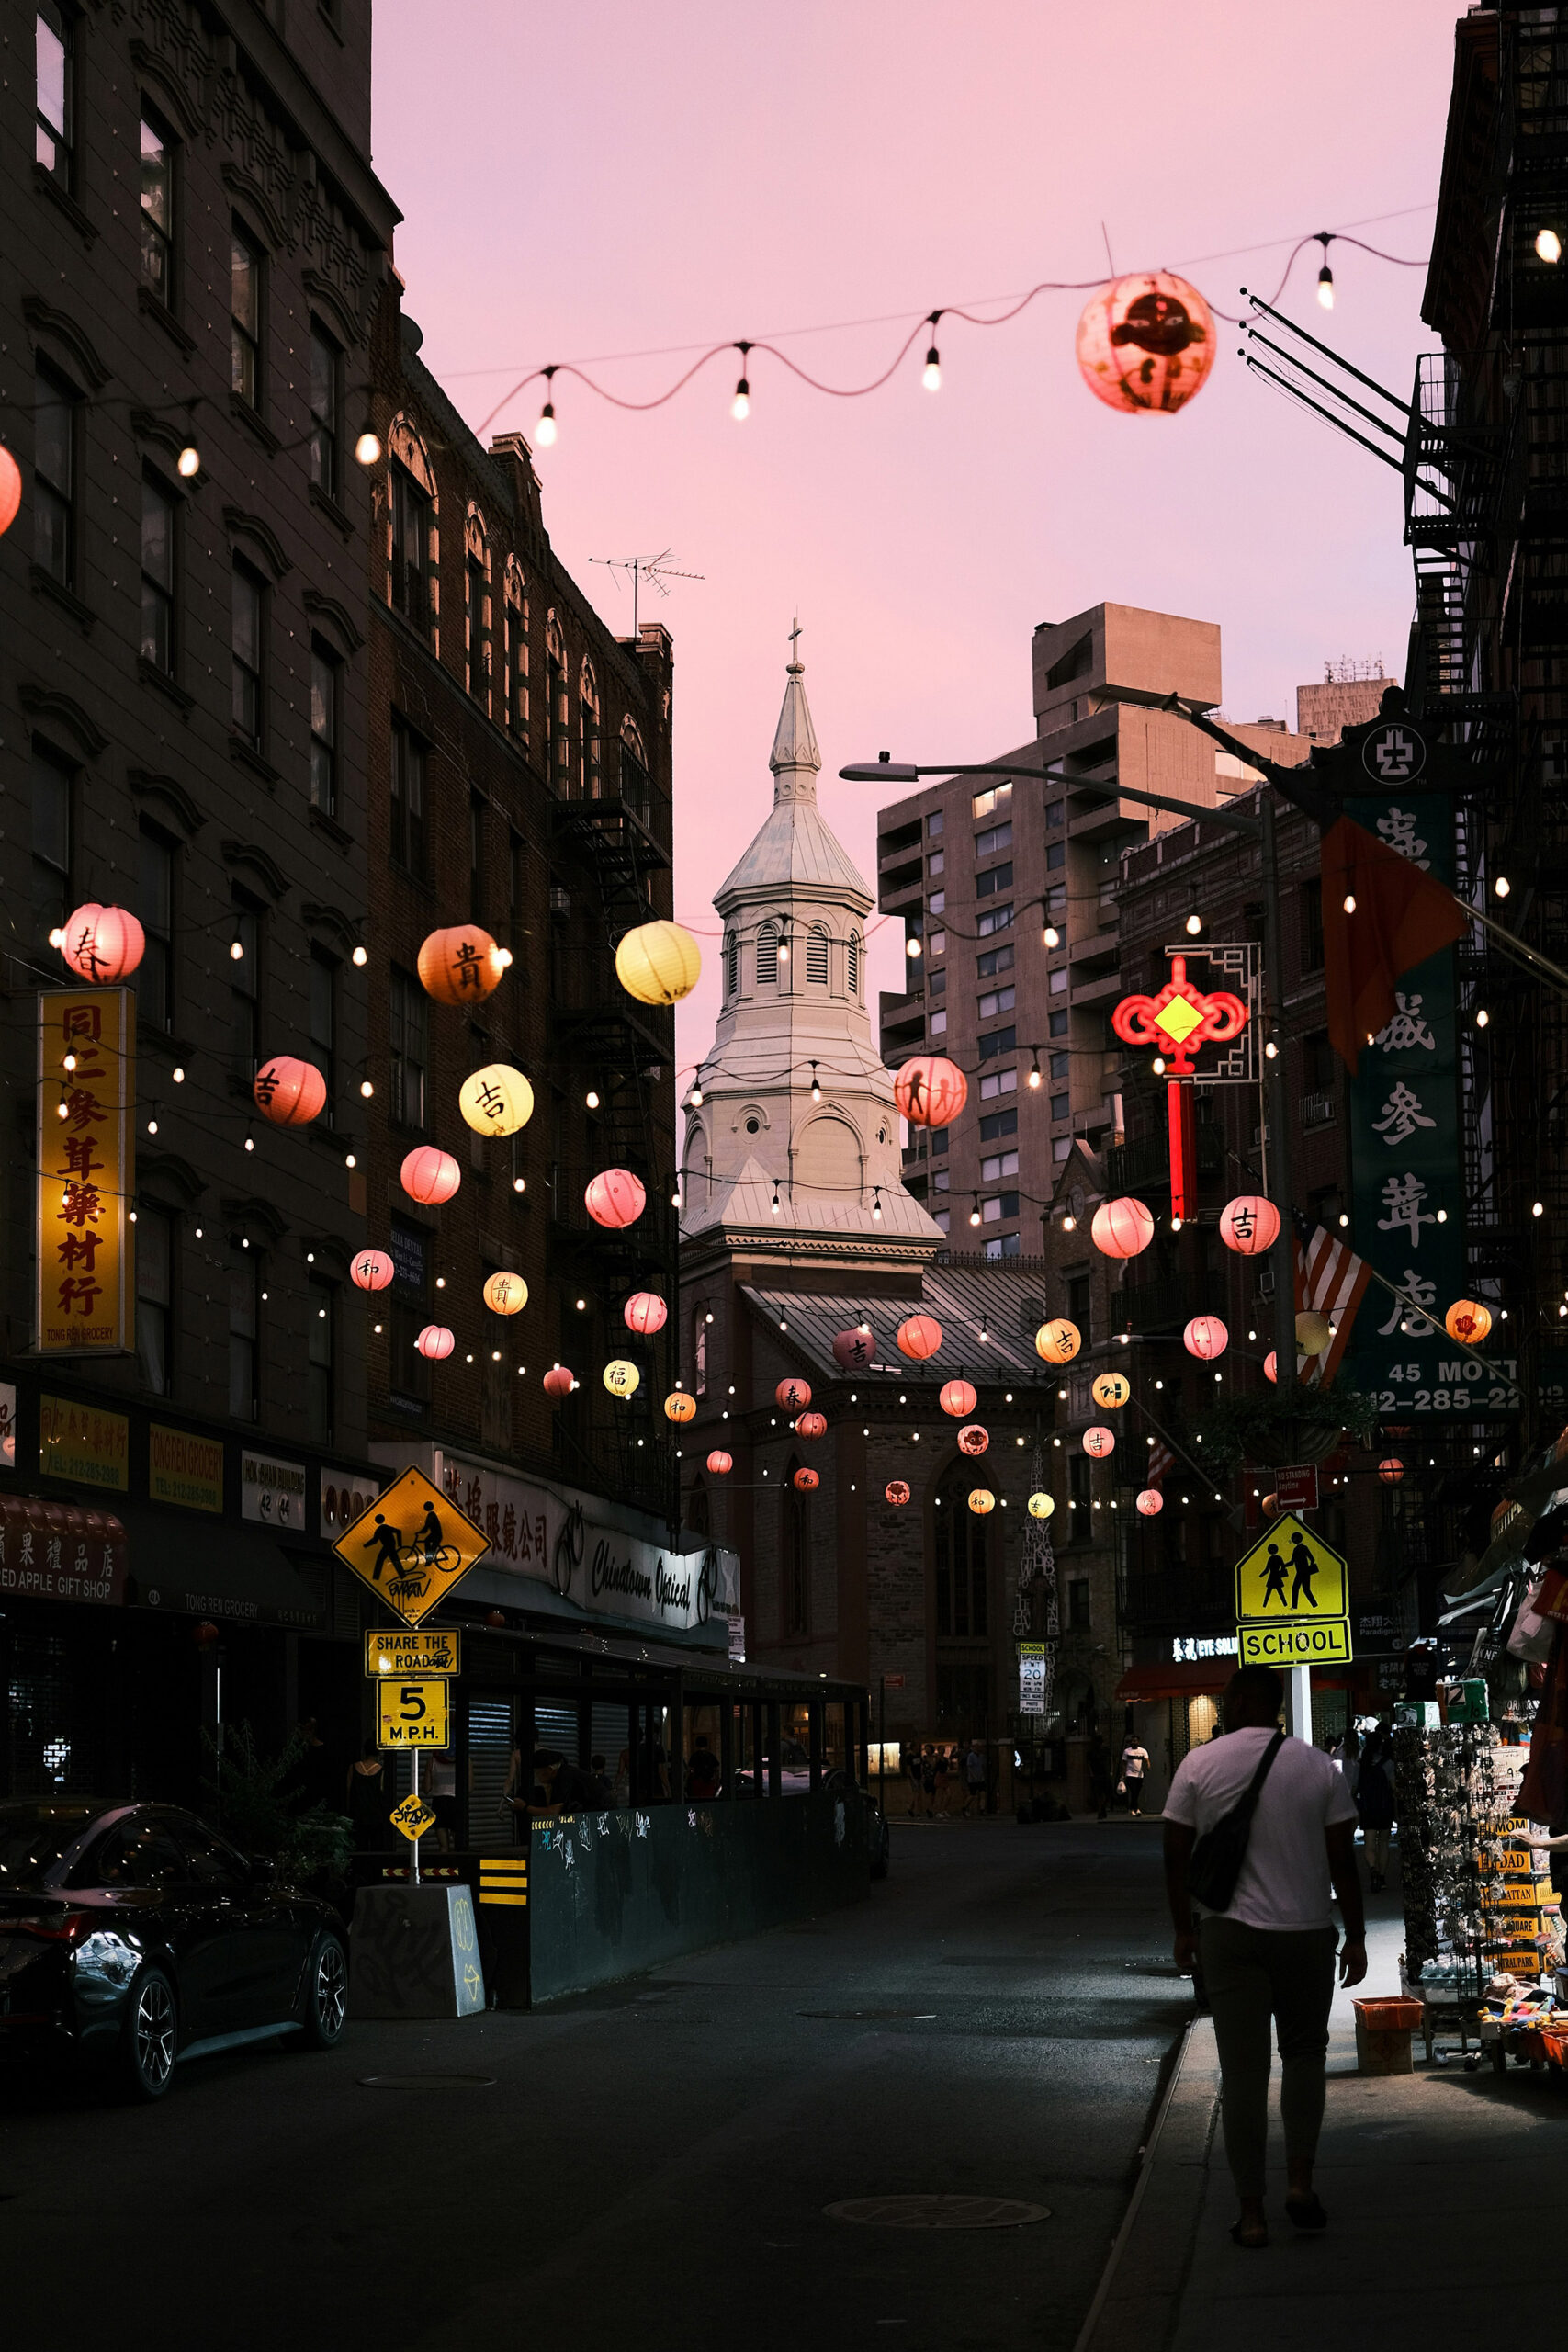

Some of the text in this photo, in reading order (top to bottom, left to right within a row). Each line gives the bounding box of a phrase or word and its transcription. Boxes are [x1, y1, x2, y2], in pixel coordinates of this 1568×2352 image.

[452, 943, 484, 989] 貴
[256, 1069, 280, 1105] 吉
[475, 1081, 505, 1119] 吉
[1230, 1207, 1258, 1240] 吉
[358, 1259, 380, 1277] 和
[47, 1328, 65, 1342] TONG
[1056, 1329, 1076, 1353] 吉
[608, 1365, 626, 1386] 福
[1388, 1360, 1517, 1383] 45 MOTT
[671, 1399, 687, 1416] 和
[1093, 1433, 1106, 1453] 吉
[262, 1495, 270, 1511] 42
[18, 1571, 52, 1592] APPLE
[57, 1577, 82, 1596] GIFT
[82, 1579, 111, 1600] SHOP
[592, 1538, 691, 1617] Chinatown Optical
[185, 1593, 206, 1611] TONG
[208, 1596, 223, 1615] REN
[377, 1635, 449, 1651] SHARE THE
[1021, 1645, 1043, 1653] SCHOOL
[1198, 1638, 1215, 1657] EYE
[1246, 1627, 1343, 1656] SCHOOL
[396, 1654, 431, 1668] ROAD
[1024, 1668, 1041, 1680] 20
[400, 1687, 426, 1721] 5
[389, 1726, 439, 1739] M.P.H.
[1495, 1820, 1526, 1834] MOM
[1500, 1854, 1525, 1869] DAD
